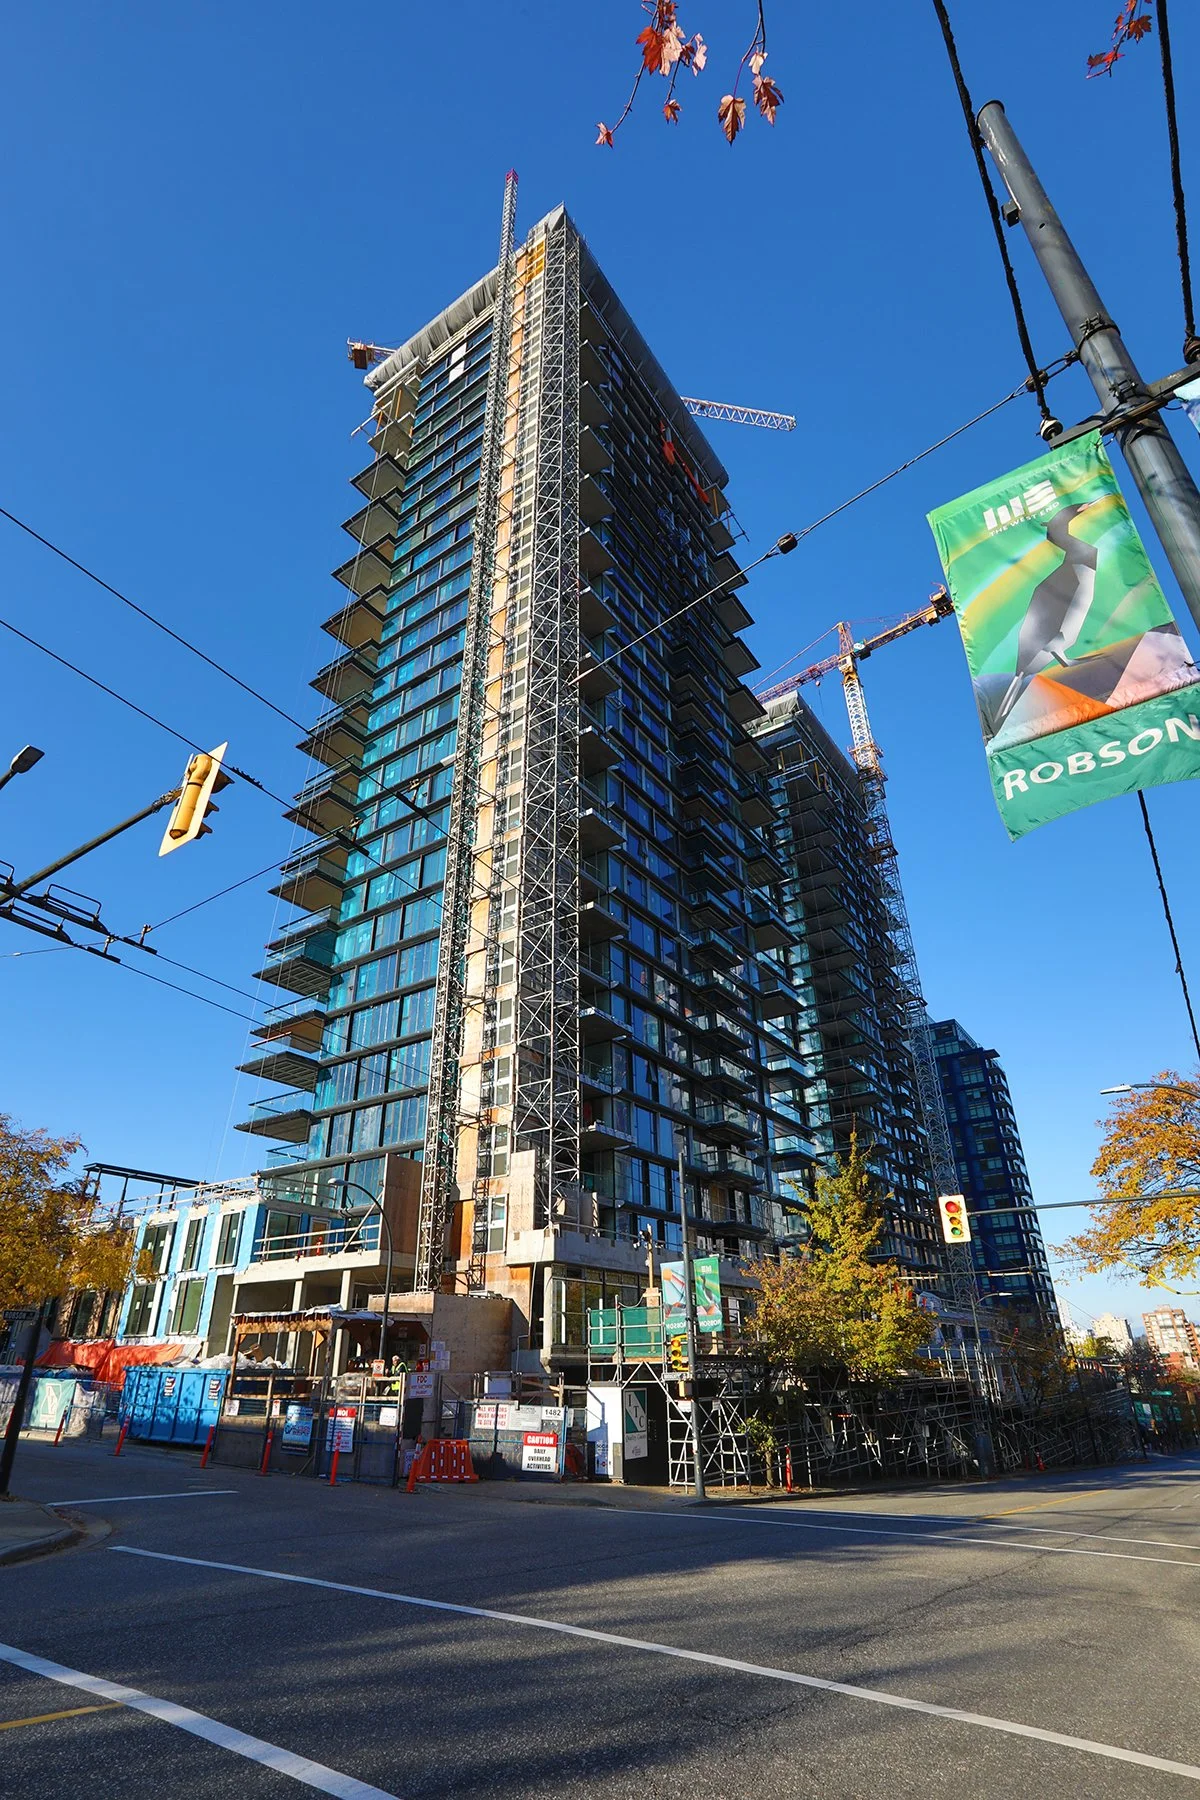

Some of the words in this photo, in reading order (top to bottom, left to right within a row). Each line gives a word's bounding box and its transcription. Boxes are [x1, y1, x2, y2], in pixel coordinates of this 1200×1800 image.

[991, 525, 1008, 537] THE
[1010, 513, 1037, 527] WEST
[1039, 501, 1060, 517] END
[1003, 714, 1200, 800] ROBSON
[545, 1408, 561, 1416] 1482
[627, 1394, 645, 1428] ITC
[526, 1435, 555, 1445] CAUTION
